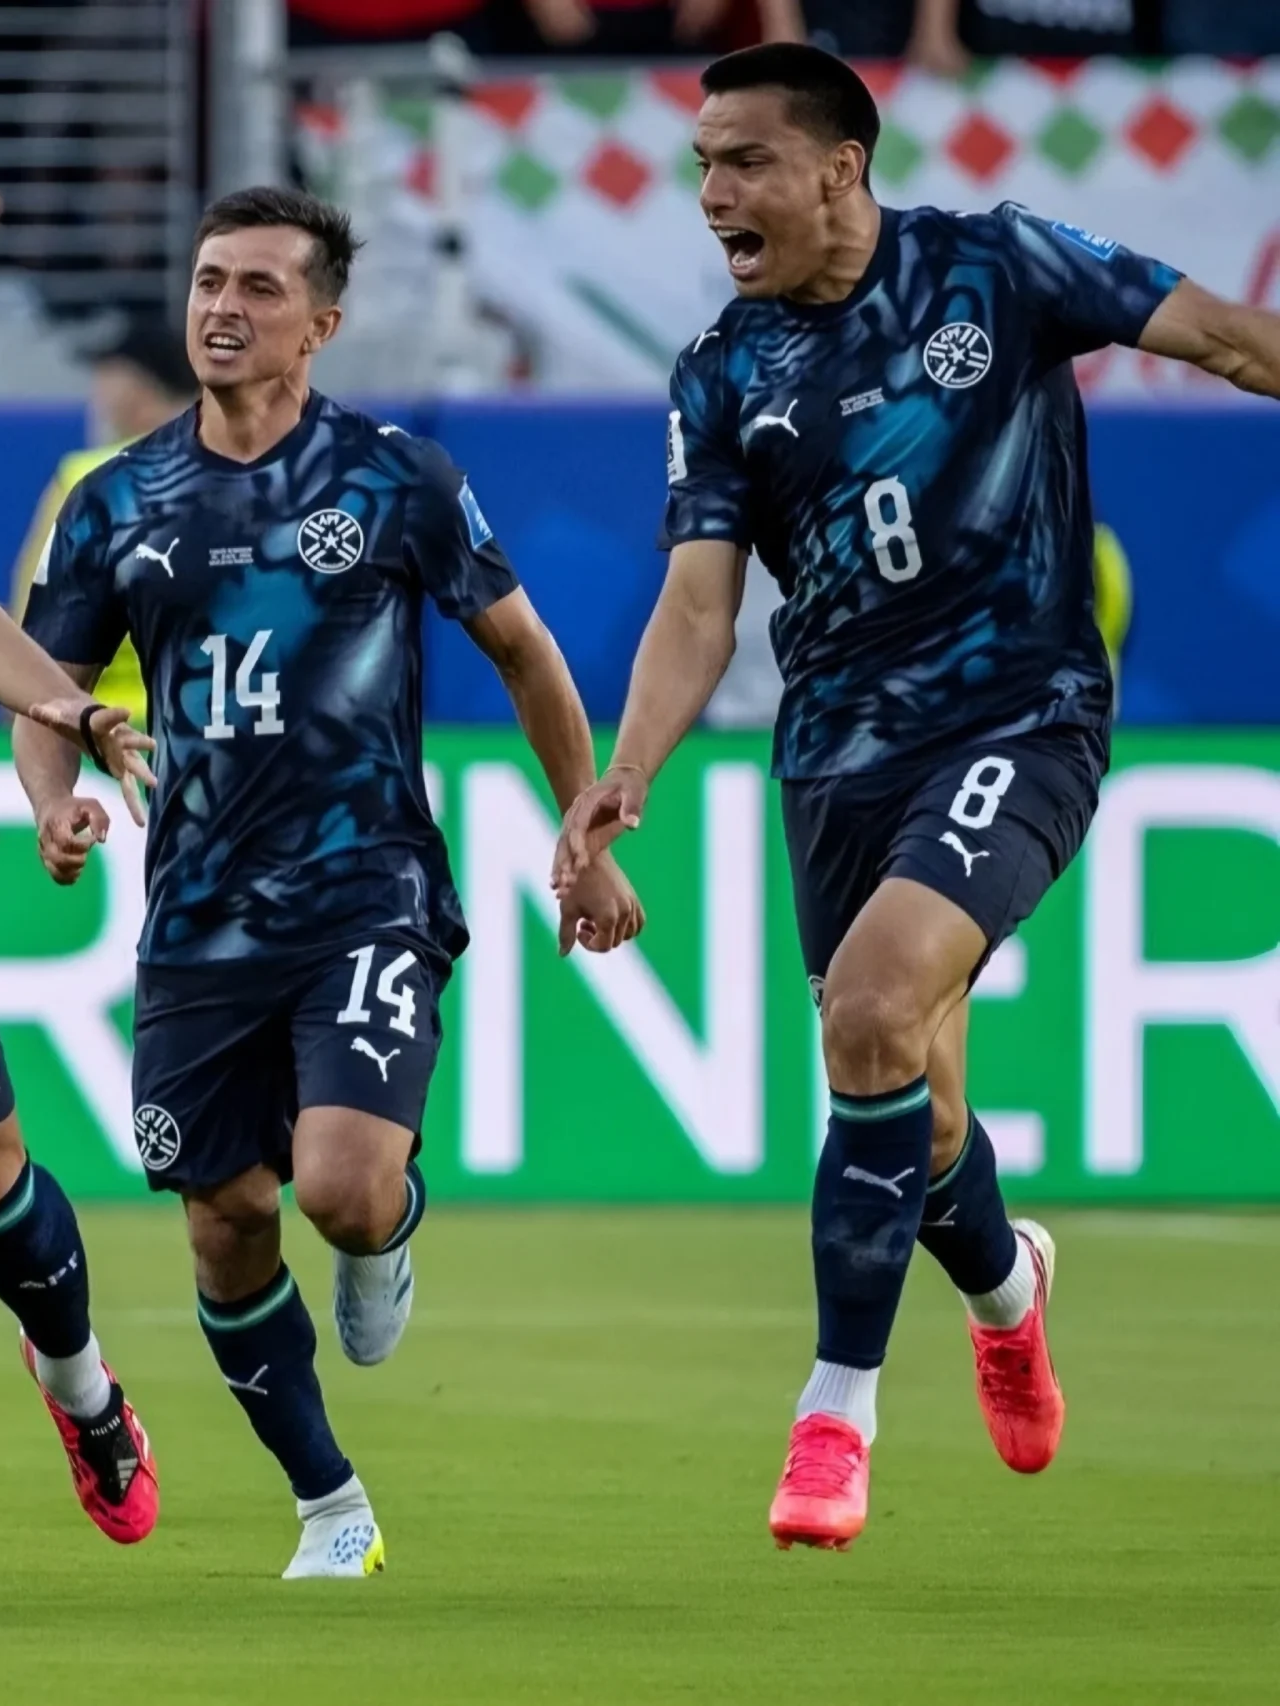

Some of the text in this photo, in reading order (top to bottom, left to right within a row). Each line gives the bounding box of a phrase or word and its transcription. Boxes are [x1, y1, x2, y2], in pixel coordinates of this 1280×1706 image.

[863, 474, 923, 583] 8
[199, 628, 285, 740] 14
[947, 755, 1016, 829] 8
[336, 943, 417, 1039] 14
